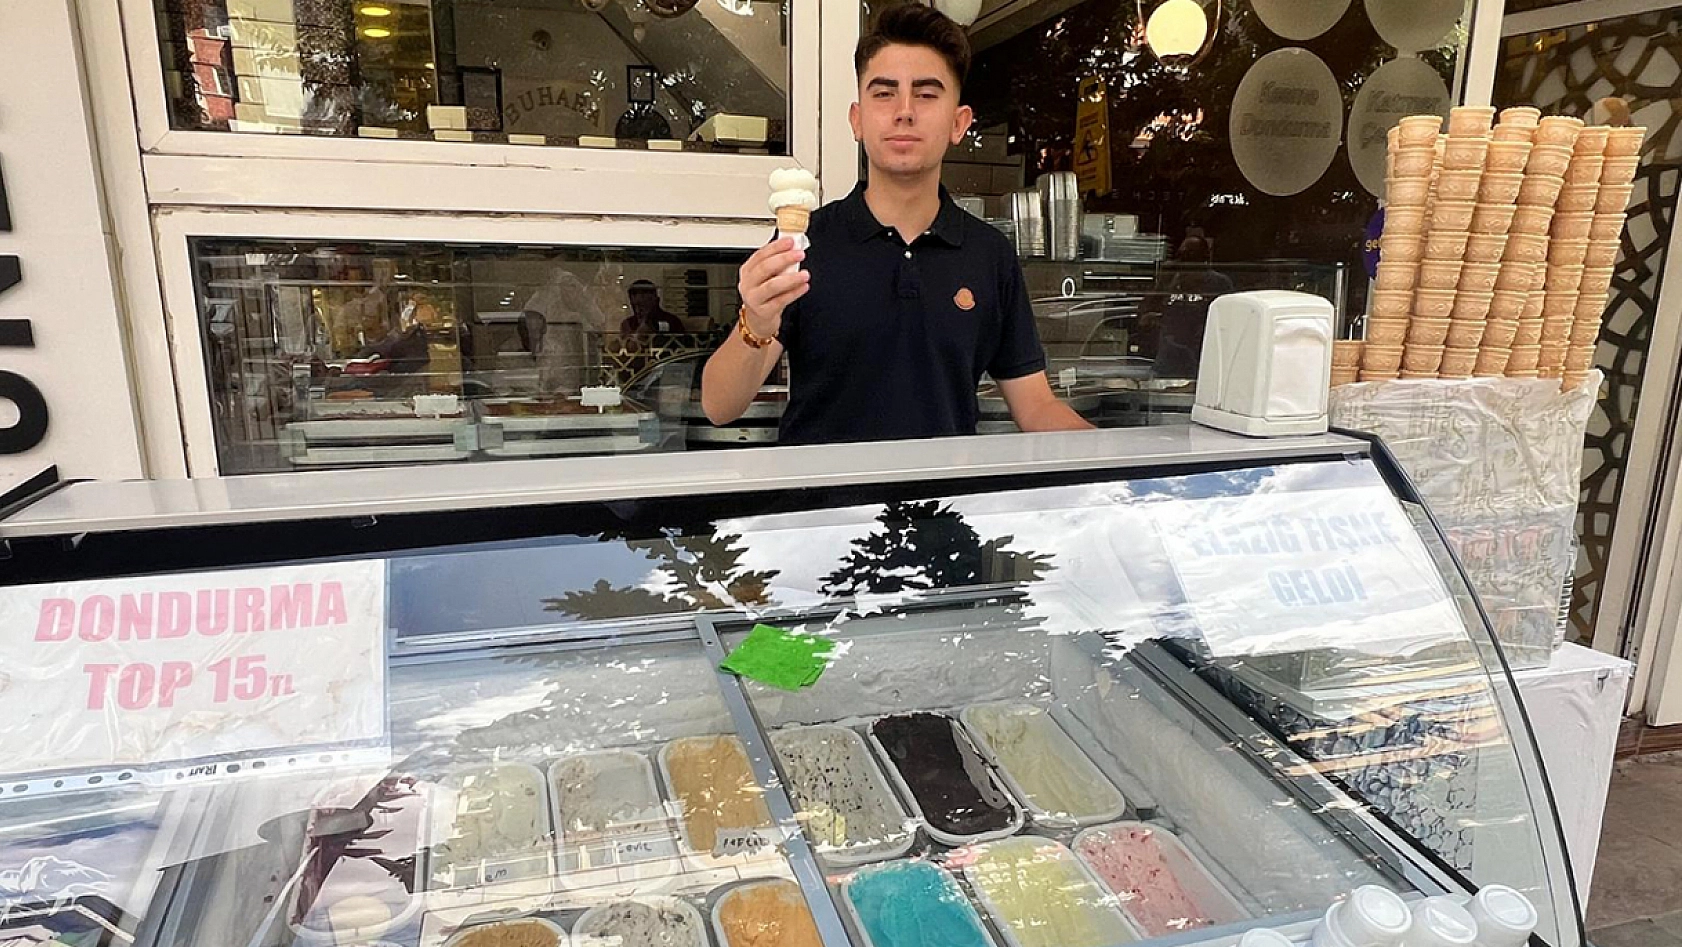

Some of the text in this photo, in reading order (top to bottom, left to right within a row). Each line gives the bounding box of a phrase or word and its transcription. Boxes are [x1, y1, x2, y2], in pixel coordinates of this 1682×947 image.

[34, 580, 348, 643] DONDURMA
[83, 654, 296, 711] TOP 15TL
